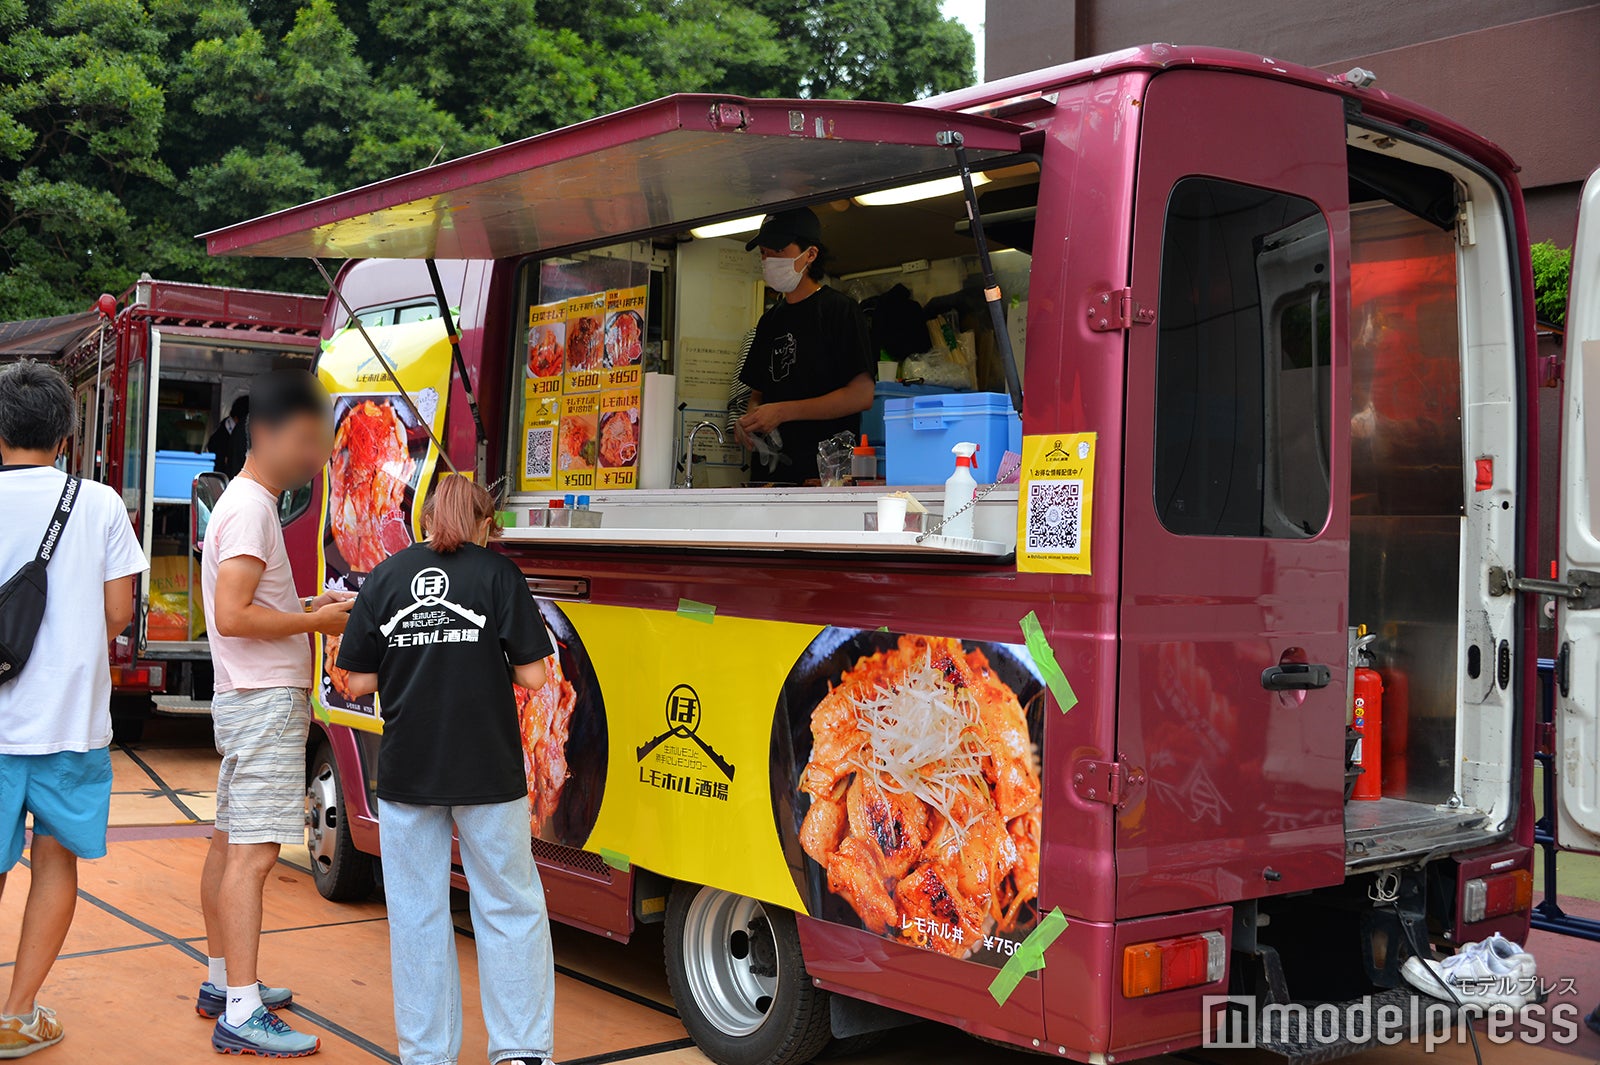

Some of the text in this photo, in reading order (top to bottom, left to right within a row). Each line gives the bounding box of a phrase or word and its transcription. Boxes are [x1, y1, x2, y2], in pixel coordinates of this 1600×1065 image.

[571, 372, 599, 388] ¥680
[608, 369, 638, 385] ¥850
[532, 379, 560, 394] ¥300
[564, 473, 592, 487] ¥500
[603, 471, 633, 485] ¥750
[60, 478, 78, 513] goleador
[40, 520, 62, 561] goleador
[416, 575, 446, 596] ほ
[669, 695, 698, 724] ほ
[663, 744, 700, 760] 生ホルモンと
[655, 753, 708, 771] 勝手にレモンサワー
[639, 765, 729, 801] レモホル酒場
[901, 914, 965, 945] レモホル丼
